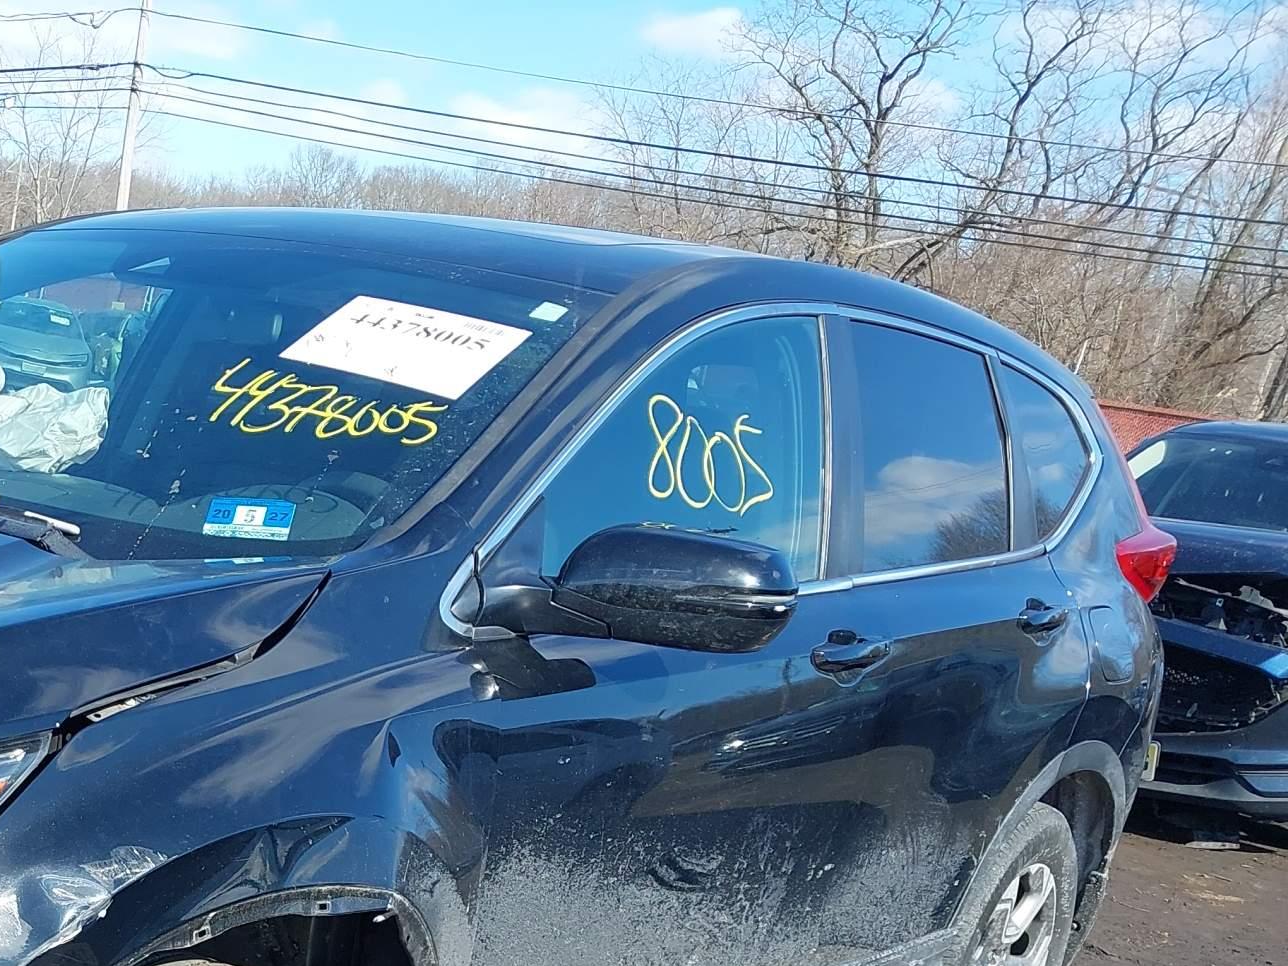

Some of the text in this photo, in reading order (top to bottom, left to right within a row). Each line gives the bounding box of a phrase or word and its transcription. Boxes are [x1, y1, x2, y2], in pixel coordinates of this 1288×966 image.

[350, 313, 491, 351] 44378005
[209, 357, 449, 445] 44378005
[648, 394, 774, 517] 8005
[212, 508, 289, 523] 20 5 27
